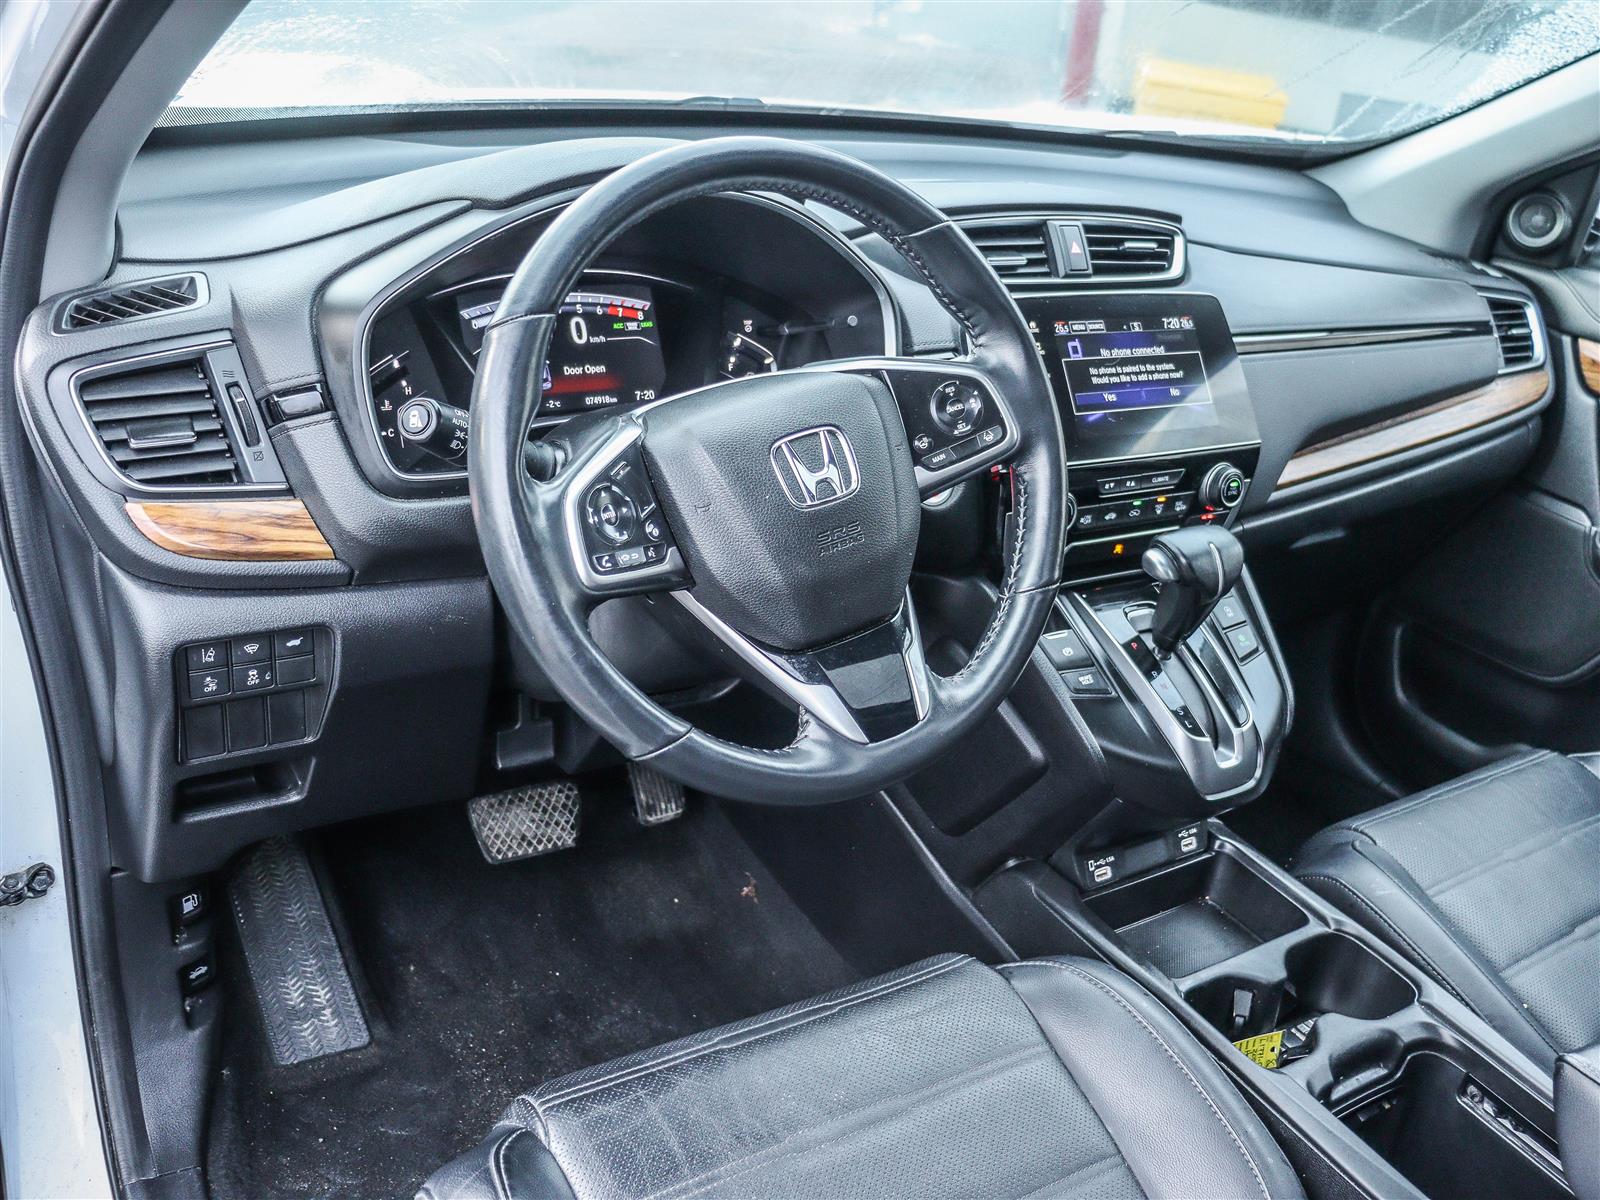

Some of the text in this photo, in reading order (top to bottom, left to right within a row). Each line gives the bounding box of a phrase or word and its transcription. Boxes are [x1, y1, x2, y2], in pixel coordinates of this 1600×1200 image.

[576, 305, 582, 314] 5
[596, 306, 602, 315] 6
[617, 308, 623, 317] 7
[638, 311, 644, 320] 8
[1162, 318, 1180, 329] 7:20
[570, 316, 606, 345] 0 km/h
[1111, 347, 1130, 357] phone
[1132, 345, 1164, 355] connected
[564, 364, 606, 375] Door Open
[1099, 366, 1116, 375] phone
[1123, 365, 1139, 374] paired
[1092, 376, 1107, 384] Would
[1121, 374, 1130, 382] like
[1138, 373, 1148, 381] add
[1153, 372, 1169, 381] phone
[405, 386, 412, 396] H
[635, 390, 655, 401] 7:20
[1170, 388, 1180, 396] No
[1103, 393, 1117, 402] Yes
[946, 404, 965, 413] CANCEL
[452, 418, 467, 428] AUTO
[387, 429, 394, 437] C
[932, 454, 946, 463] MAIN
[818, 522, 860, 545] SRS
[1131, 642, 1138, 650] P
[1177, 708, 1184, 716] S
